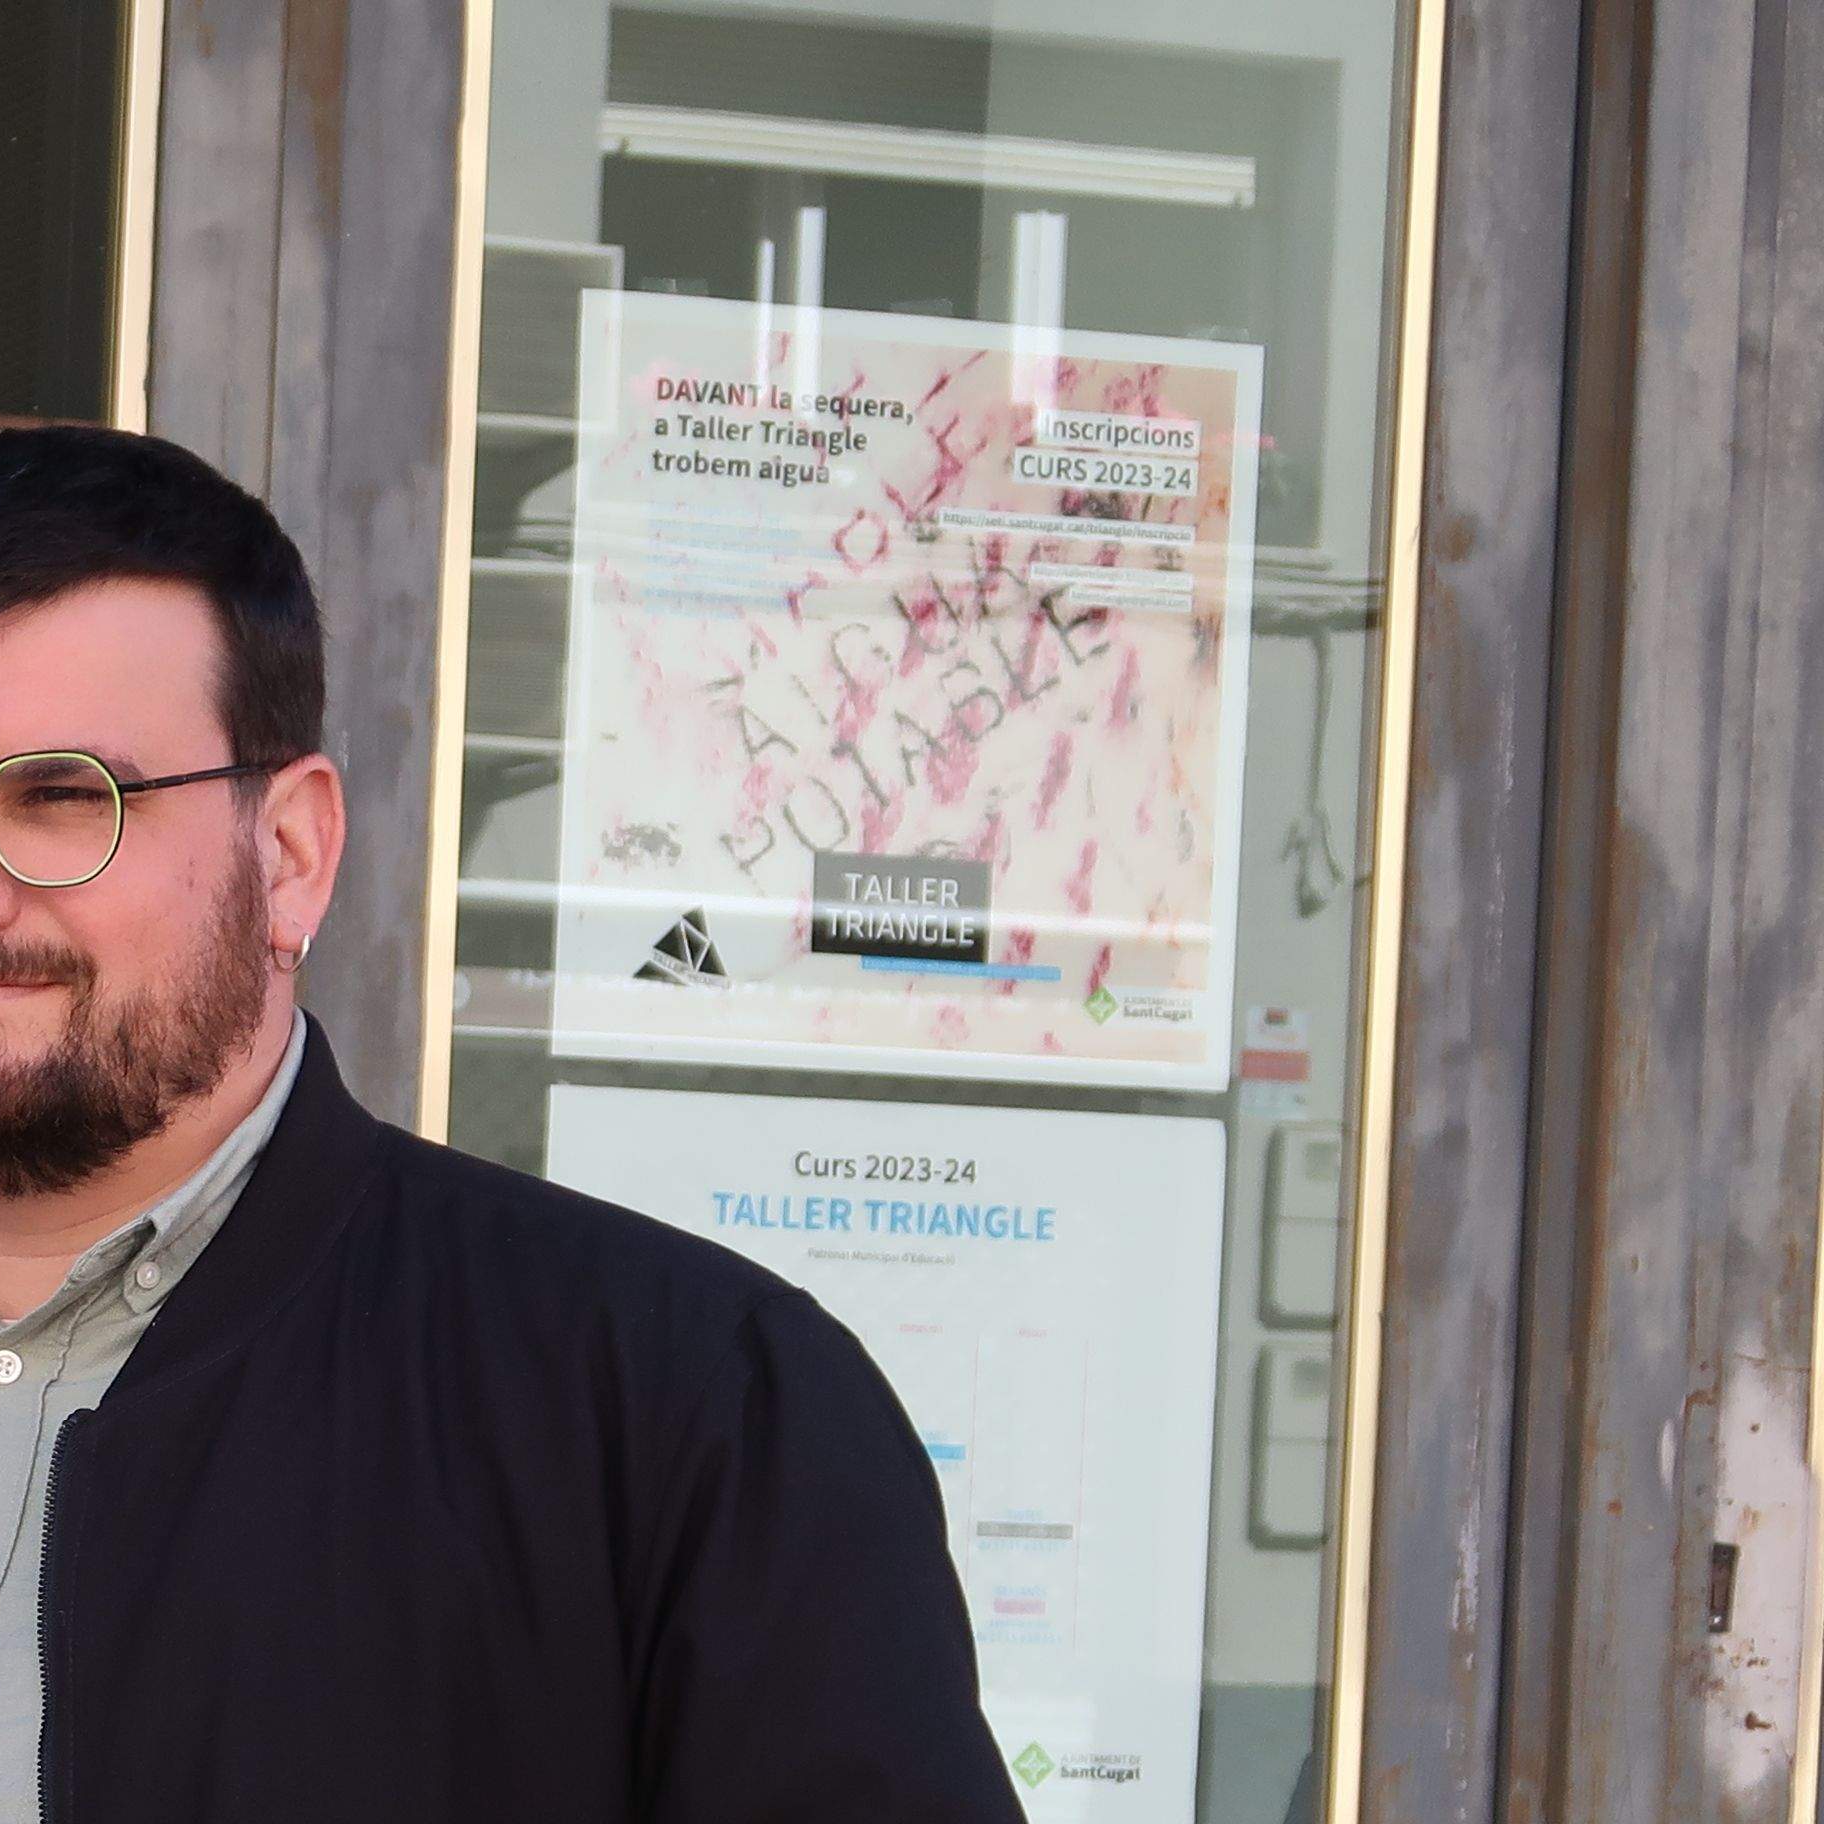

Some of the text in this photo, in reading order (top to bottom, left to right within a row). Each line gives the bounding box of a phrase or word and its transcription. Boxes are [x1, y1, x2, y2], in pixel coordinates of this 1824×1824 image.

[655, 376, 915, 425] DAVANT la sequera,
[654, 414, 868, 452] a Taller Triangle
[1043, 415, 1195, 450] Inscripcions
[652, 449, 831, 489] trobem aigua
[1019, 454, 1193, 491] CURS 2023-24
[841, 871, 960, 909] TALLER
[826, 908, 976, 947] TRIANGLE
[793, 1149, 978, 1186] Curs 2023-24
[711, 1190, 1057, 1242] TALLER TRIANGLE
